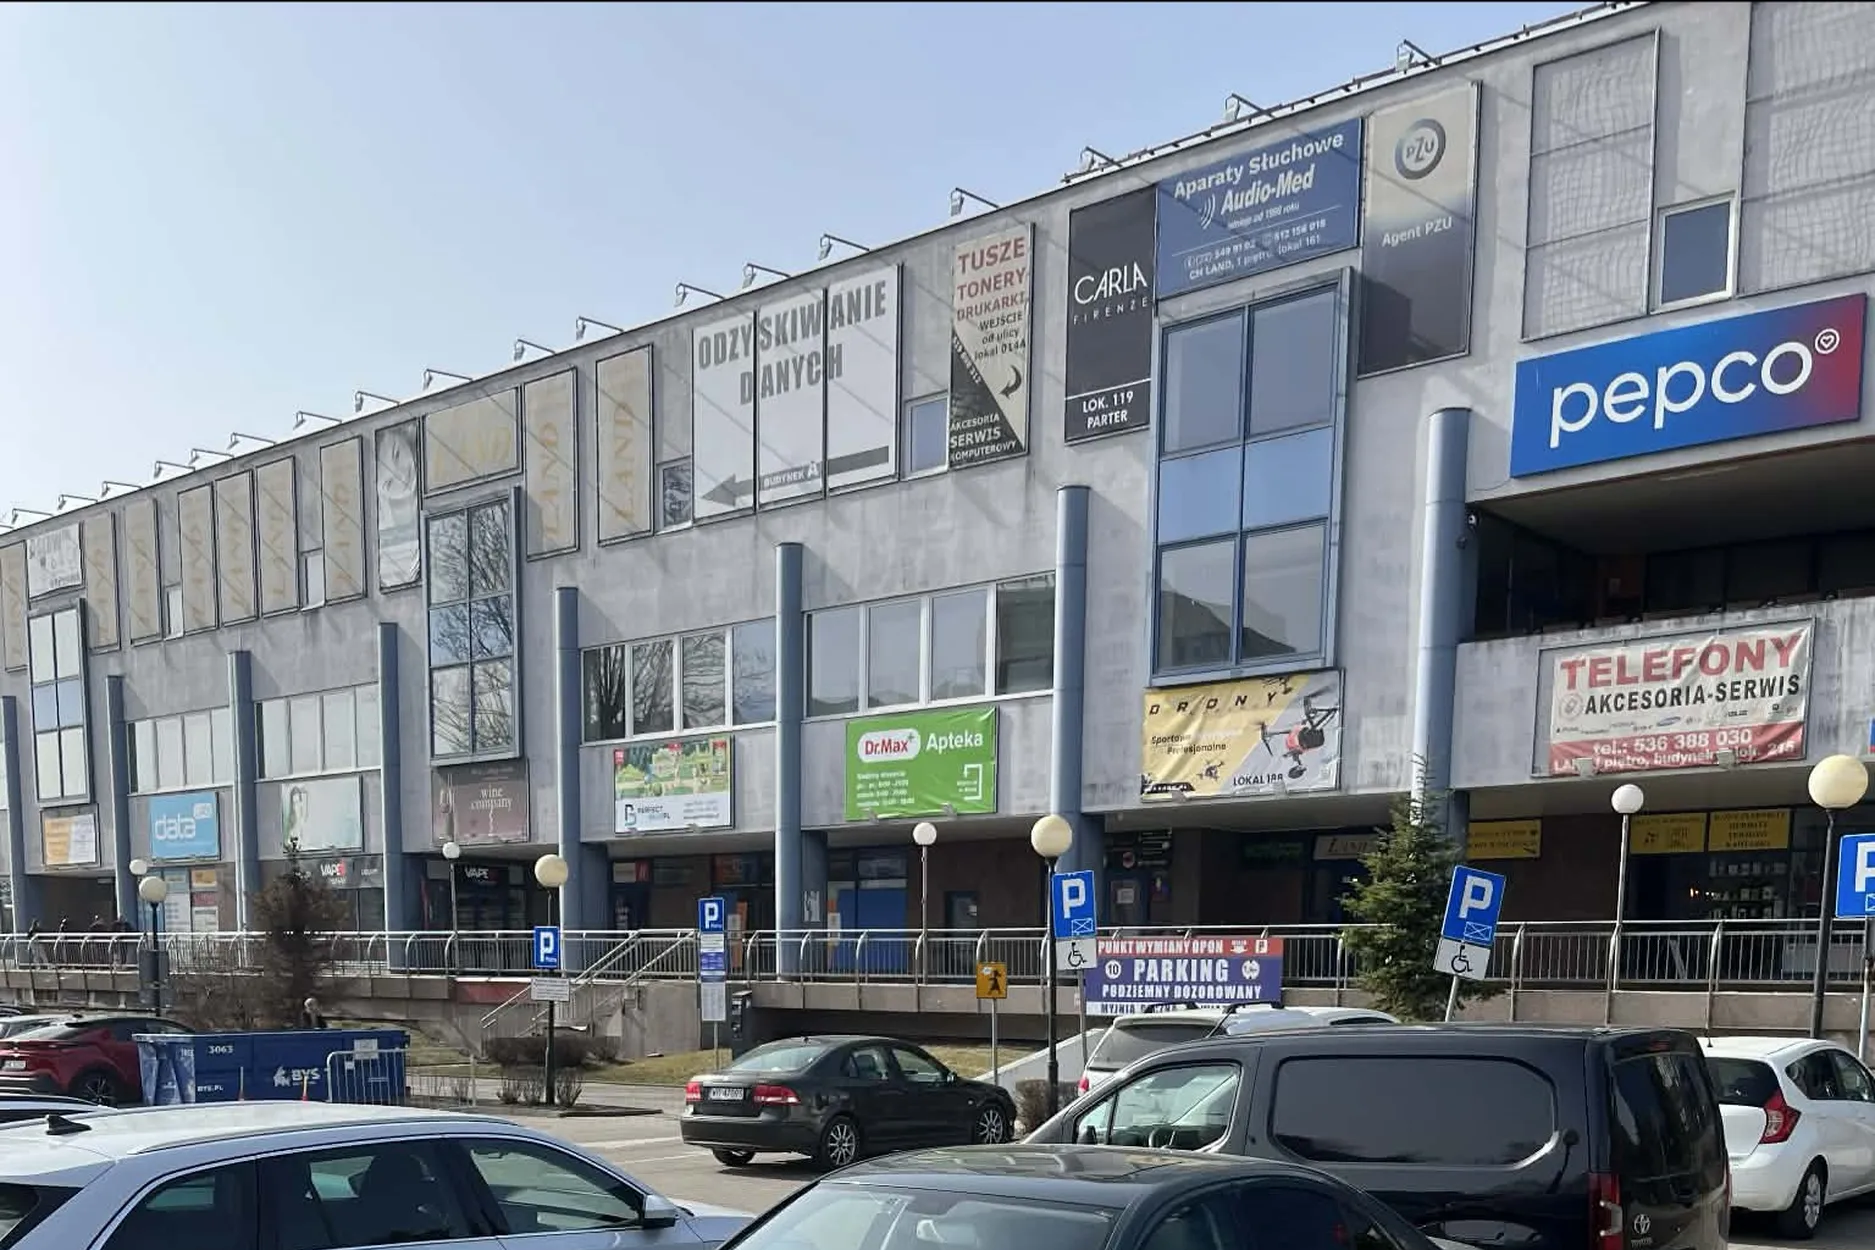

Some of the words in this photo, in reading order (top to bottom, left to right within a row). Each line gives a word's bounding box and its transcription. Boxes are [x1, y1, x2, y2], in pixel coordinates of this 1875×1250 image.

[1406, 137, 1434, 163] PZU
[1174, 165, 1244, 200] Aparaty
[1249, 133, 1344, 174] Słuchowe
[1220, 163, 1316, 215] Audio-Med
[1381, 225, 1421, 248] Agent
[1425, 216, 1453, 236] PZU
[958, 237, 1025, 274] TUSZE
[957, 267, 1026, 301] TONERY
[1074, 261, 1148, 304] CARLA
[699, 280, 886, 370] ODZYSKIWANIE
[1073, 297, 1149, 326] FIRENZE
[982, 332, 994, 345] od
[740, 343, 843, 405] DANYCH
[1082, 394, 1109, 413] LOK.
[1113, 390, 1134, 408] 119
[1549, 341, 1813, 449] pepco
[1087, 409, 1128, 430] PARTER
[950, 427, 1001, 449] SERWIS
[1560, 635, 1804, 691] TELEFONY
[1149, 692, 1277, 716] DRONY
[1585, 674, 1800, 715] AKCESORIA-SERWIS
[865, 738, 909, 756] Dr.Max
[925, 730, 983, 755] Apteka
[1593, 740, 1628, 756] tel.:
[1634, 734, 1668, 752] 536
[1716, 728, 1752, 746] 030
[480, 784, 503, 799] wine
[1233, 772, 1265, 788] LOKAL
[155, 813, 196, 841] data
[1062, 878, 1086, 919] P
[1459, 875, 1494, 918] P
[704, 902, 719, 929] P
[540, 931, 554, 963] P
[1098, 939, 1134, 955] PUNKT
[1135, 939, 1188, 955] WYMIANY
[1191, 938, 1224, 954] OPON
[1133, 958, 1229, 983] PARKING
[1102, 984, 1170, 999] PODZIEMNY
[1173, 985, 1262, 1000] DOZOROWANY
